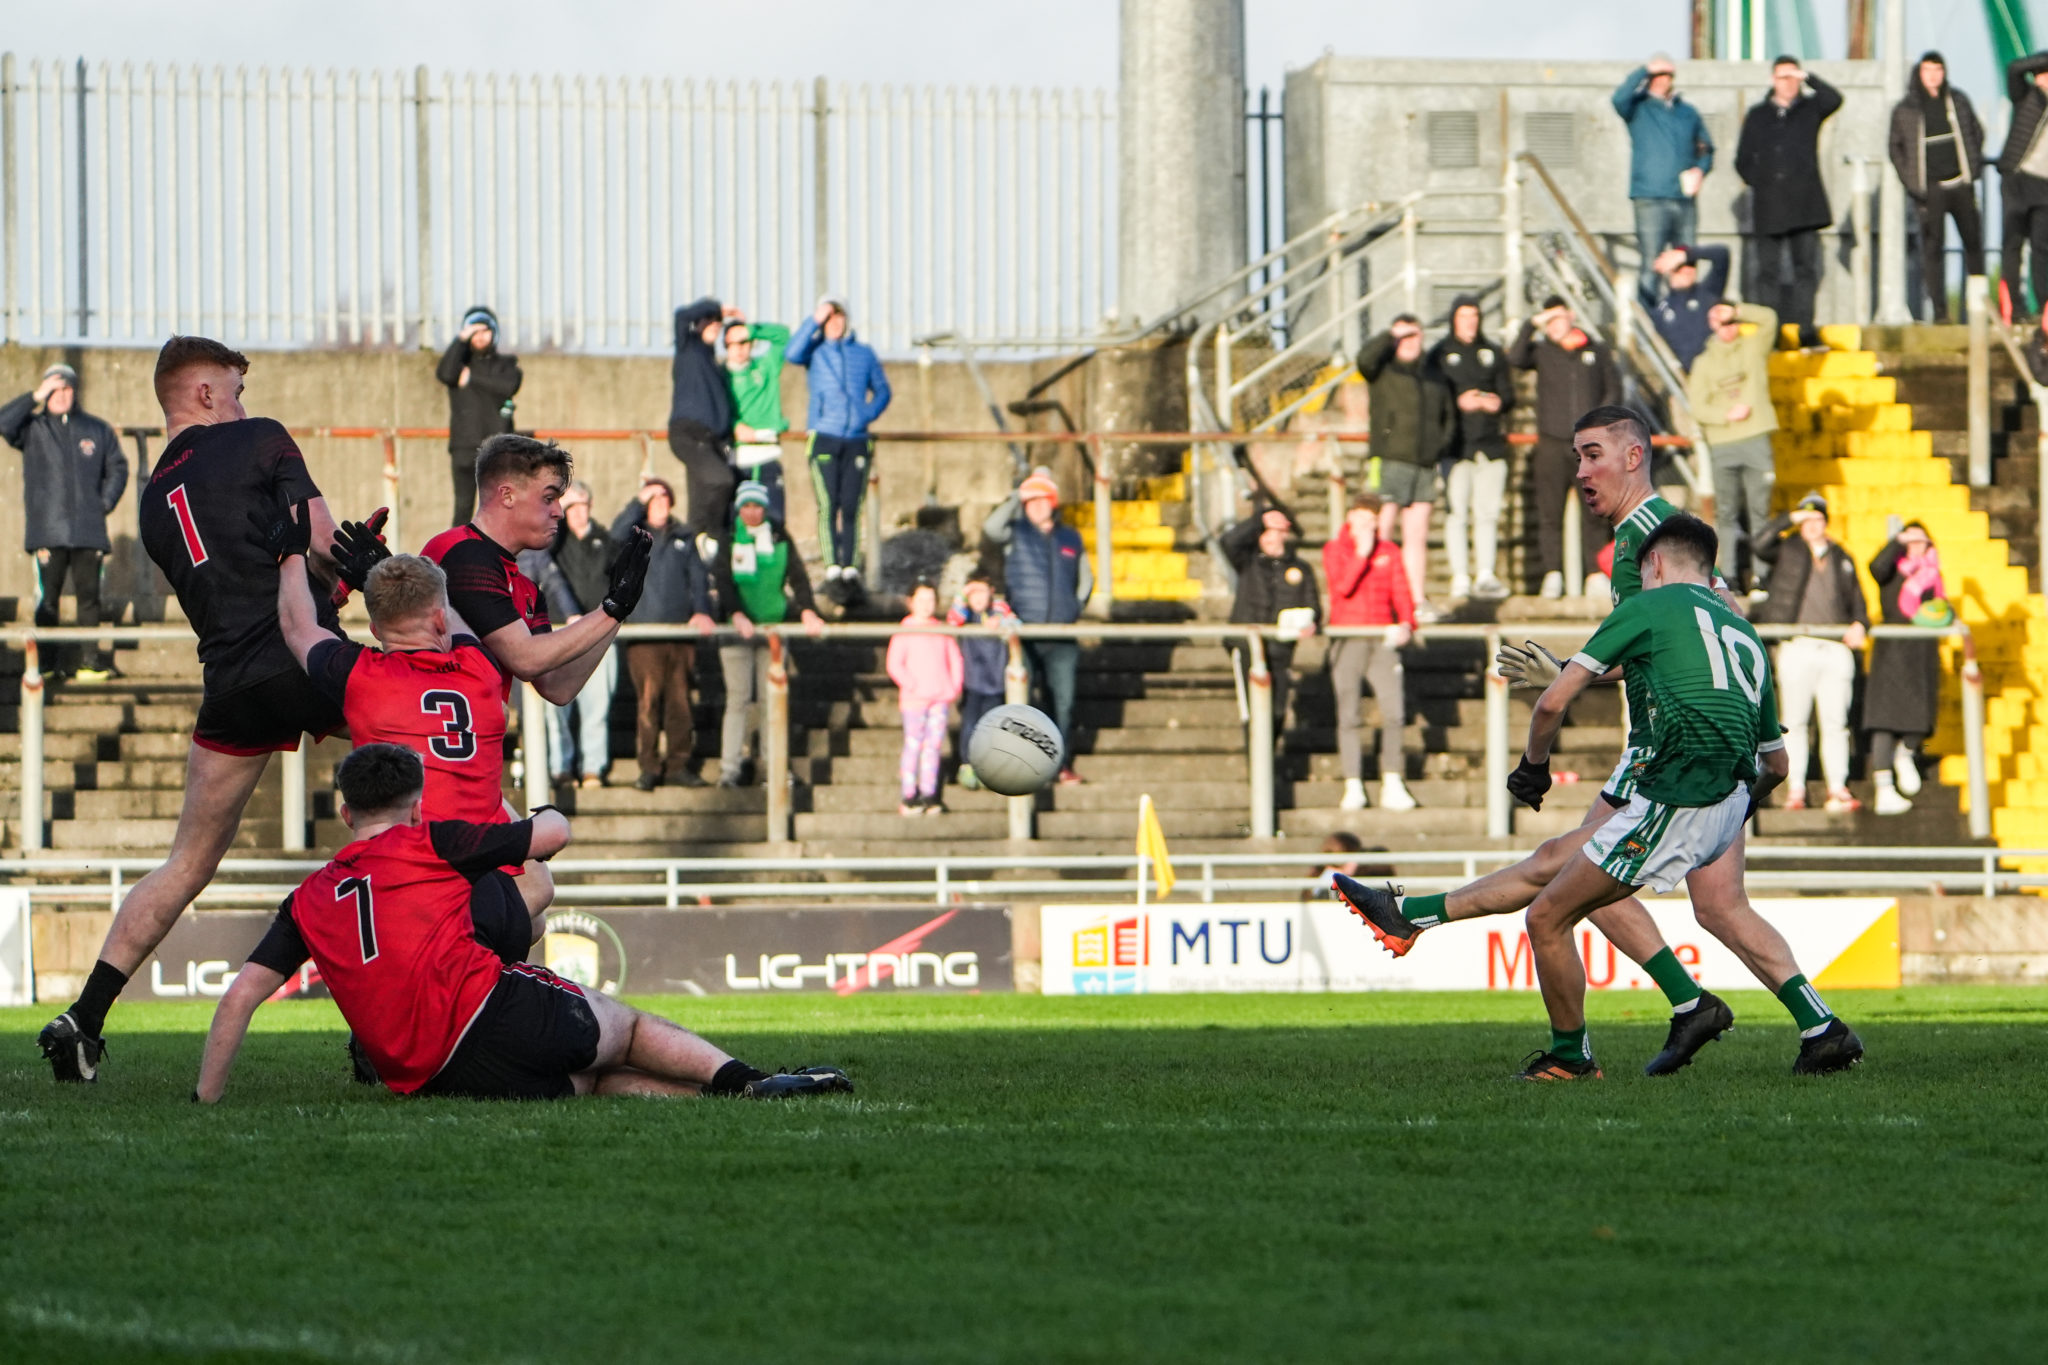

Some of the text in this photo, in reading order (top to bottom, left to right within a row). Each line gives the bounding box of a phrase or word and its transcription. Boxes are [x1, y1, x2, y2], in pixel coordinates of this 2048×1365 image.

[166, 483, 209, 568] 1
[1694, 606, 1765, 708] 10
[421, 689, 477, 762] 3
[725, 952, 979, 989] LIGHTNING
[1170, 919, 1292, 966] MTU
[1487, 931, 1703, 990] MU.e
